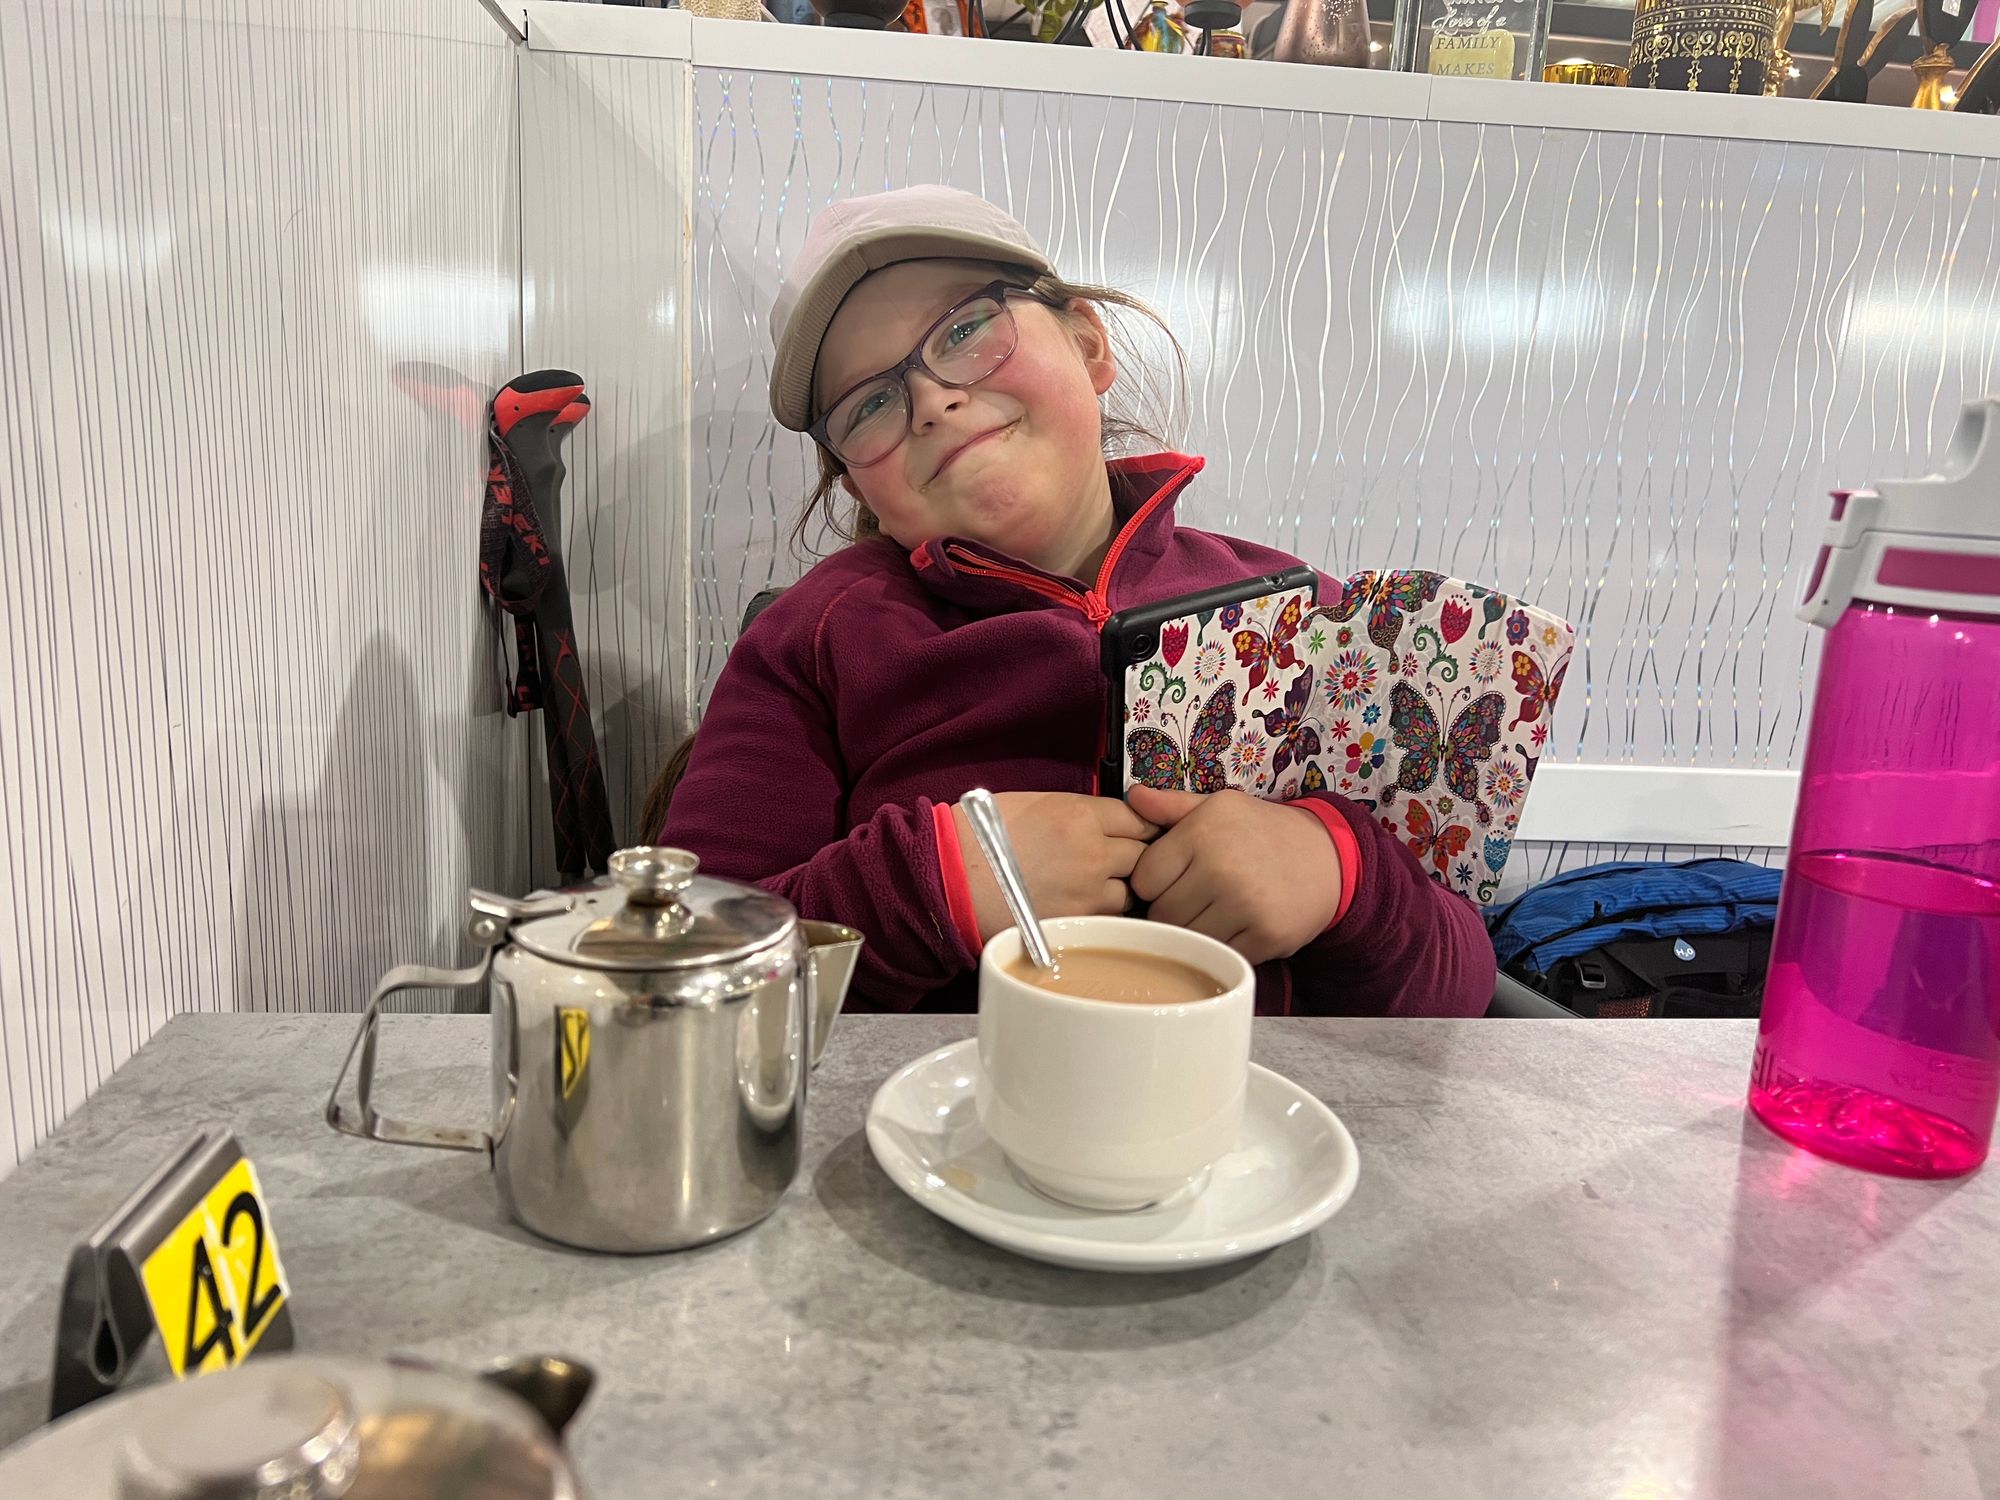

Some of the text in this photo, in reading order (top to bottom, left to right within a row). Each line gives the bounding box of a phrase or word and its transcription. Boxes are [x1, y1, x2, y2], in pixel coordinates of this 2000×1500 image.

[1477, 5, 1499, 35] of
[1496, 16, 1507, 27] a
[1436, 36, 1500, 50] FAMILY
[1437, 62, 1496, 76] MAKES
[184, 1190, 282, 1370] 42
